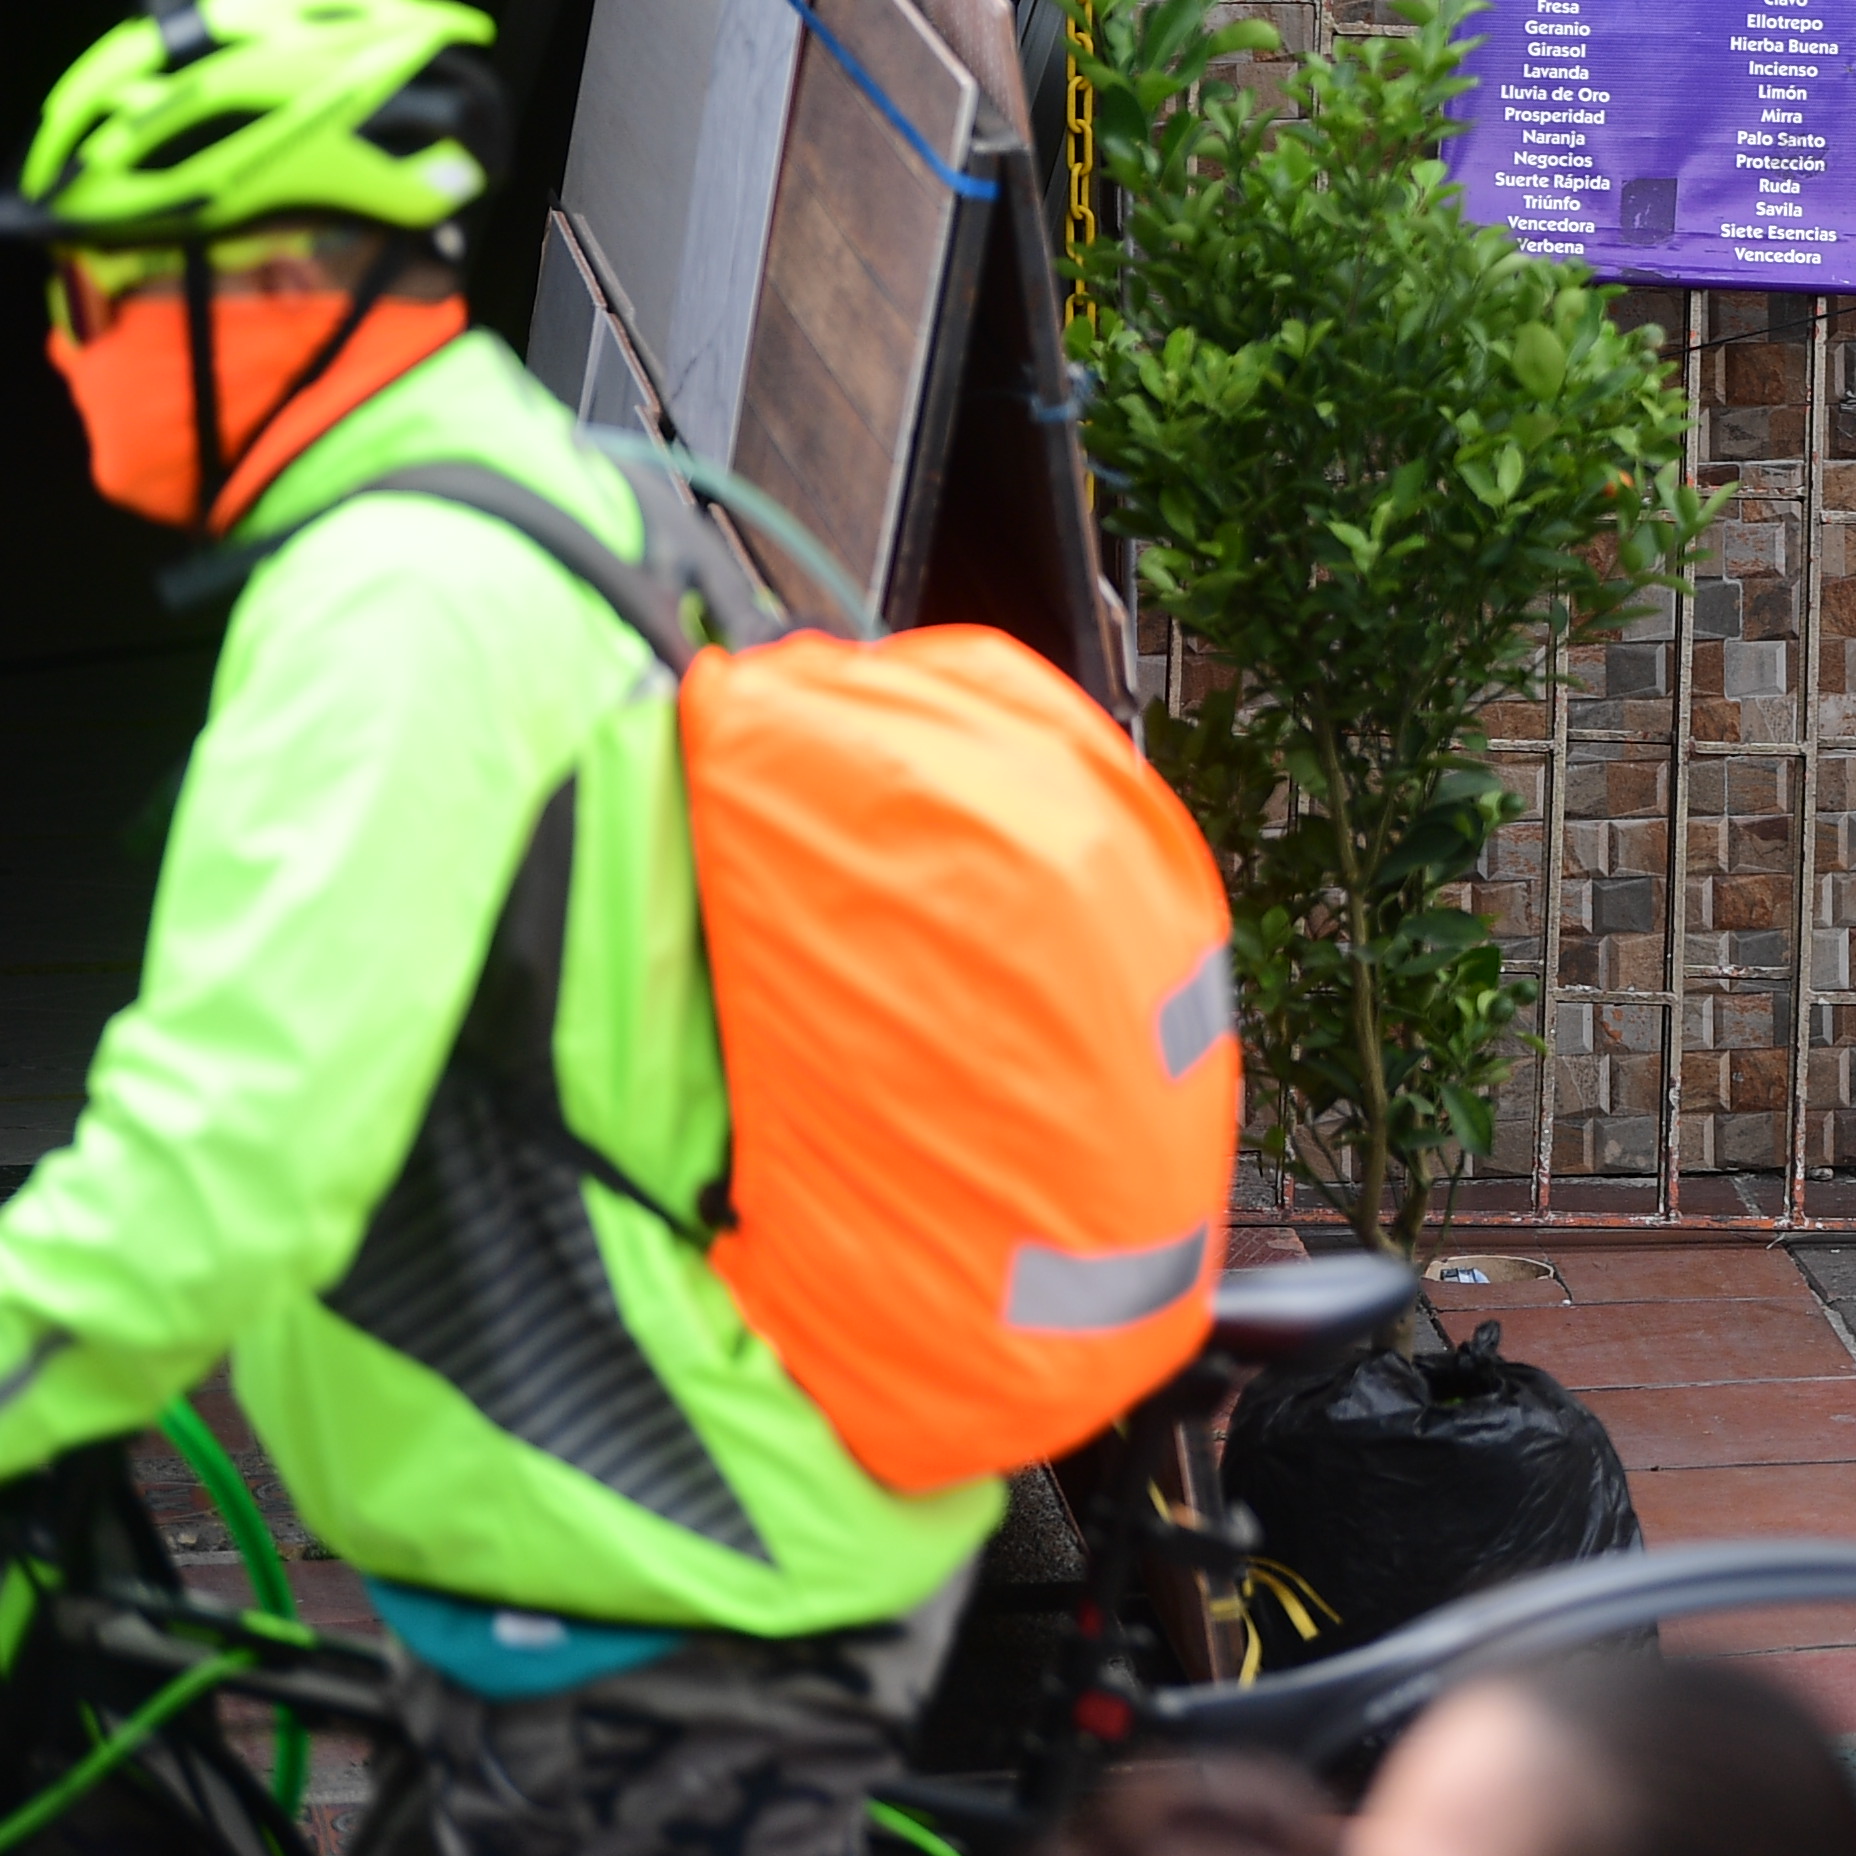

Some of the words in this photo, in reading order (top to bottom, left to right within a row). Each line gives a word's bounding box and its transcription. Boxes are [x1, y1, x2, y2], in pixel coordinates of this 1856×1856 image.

[1524, 19, 1591, 37] Geranio
[1730, 36, 1784, 53] Hierba
[1788, 38, 1839, 55] Buena
[1748, 60, 1819, 78] Incienso
[1500, 84, 1548, 101] Lluvia
[1551, 86, 1574, 102] de
[1577, 87, 1611, 103] Oro
[1507, 215, 1595, 234] Vencedora
[1720, 223, 1764, 239] Siete
[1767, 225, 1837, 242] Esencias
